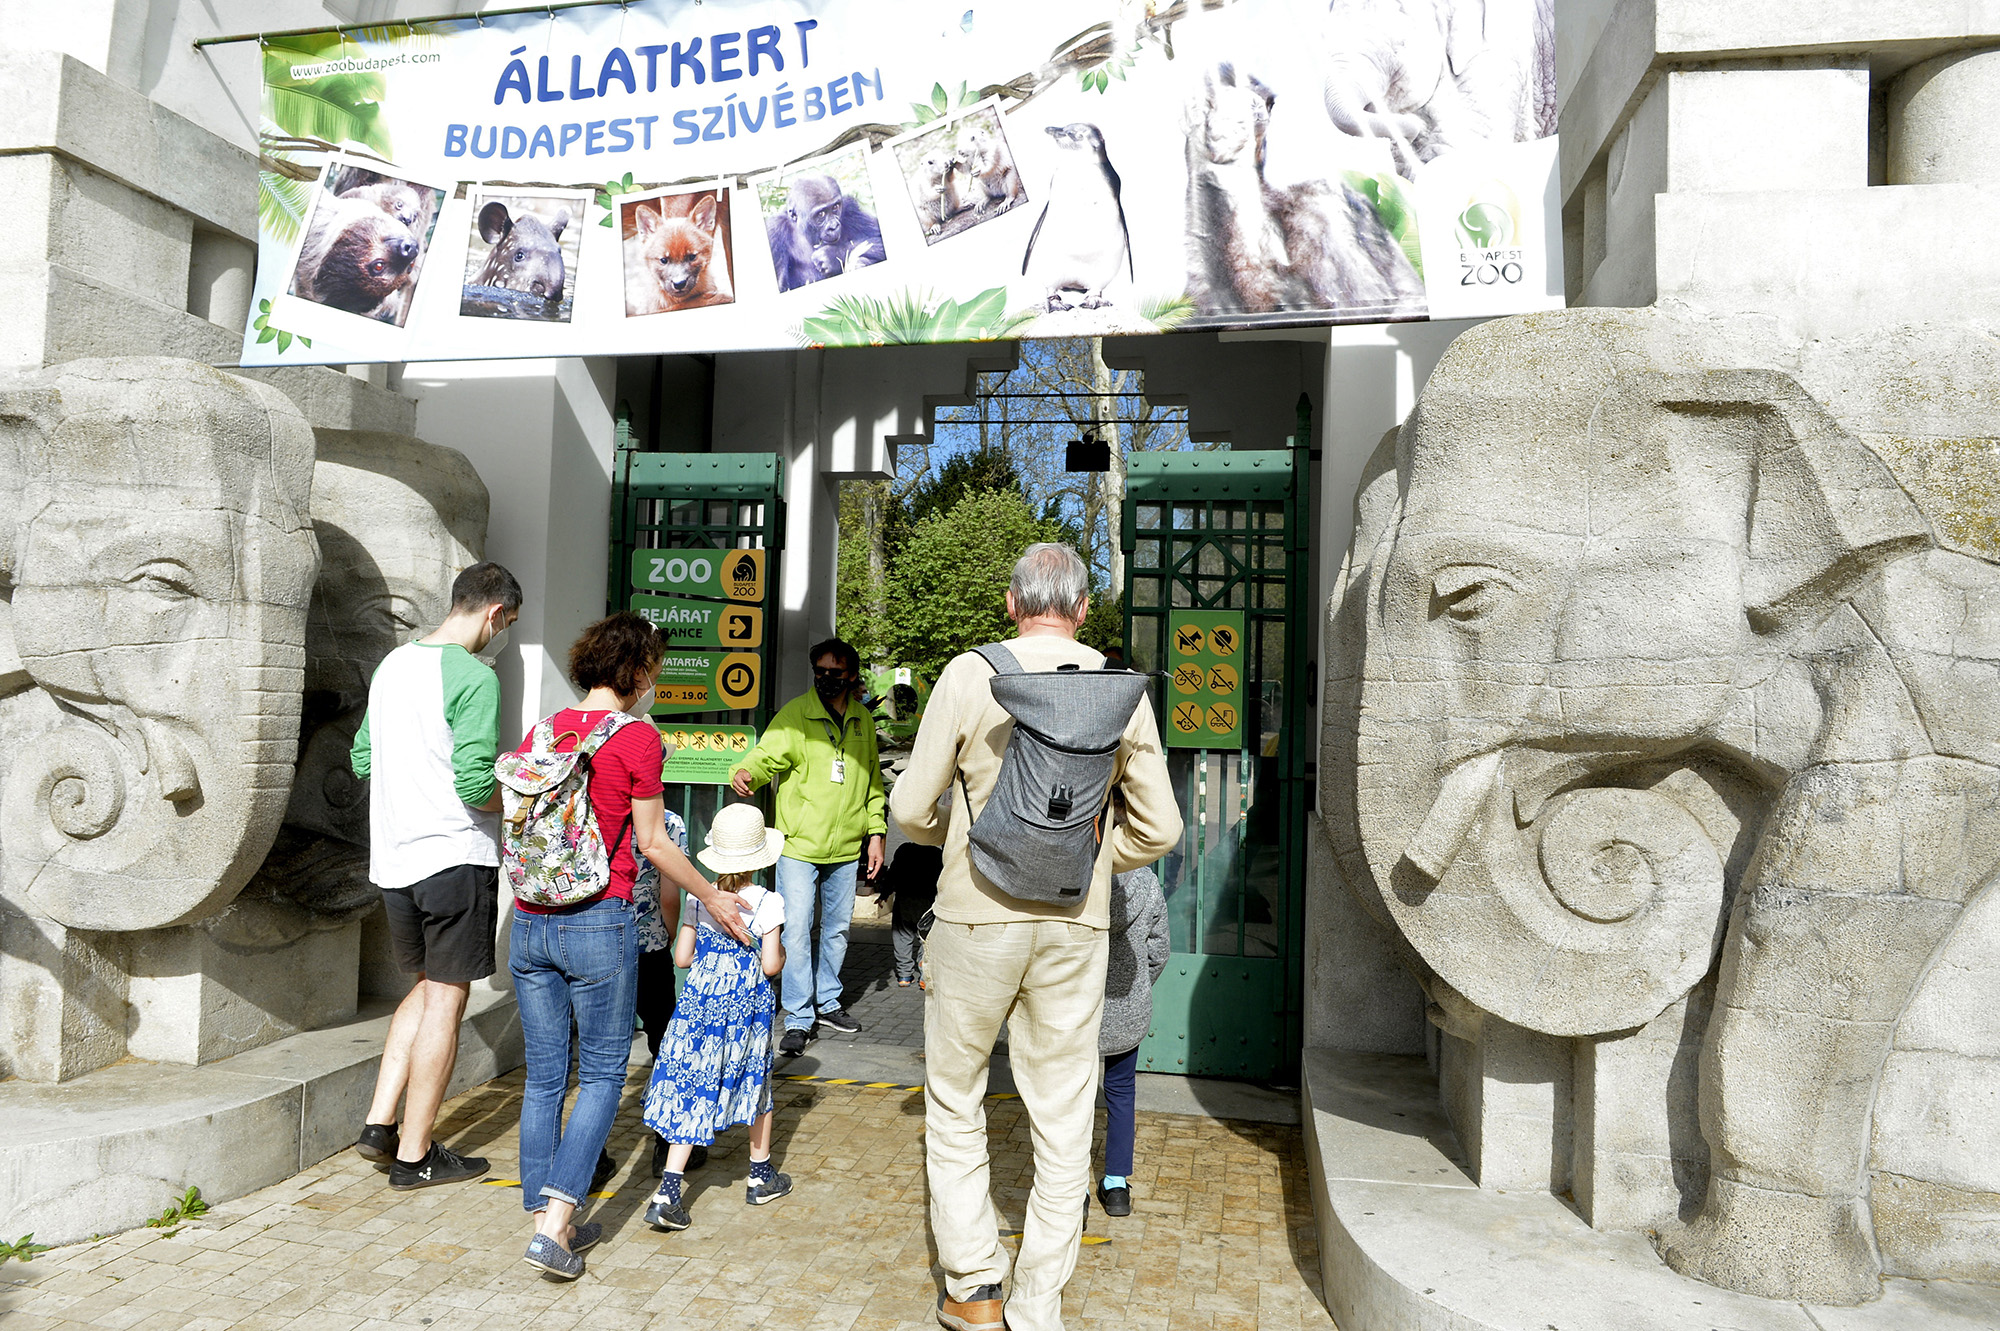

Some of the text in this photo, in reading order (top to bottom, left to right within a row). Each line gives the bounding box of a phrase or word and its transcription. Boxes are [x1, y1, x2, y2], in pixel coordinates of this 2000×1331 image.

[292, 52, 441, 78] www.zoobudapest.com
[493, 18, 818, 106] ÁLLATKERT
[443, 66, 884, 160] BUDAPEST SZÍVÉBEN
[1460, 262, 1523, 287] ZOO
[648, 557, 712, 584] ZOO
[733, 586, 756, 596] ZOO
[639, 605, 712, 624] BEJÁRAT
